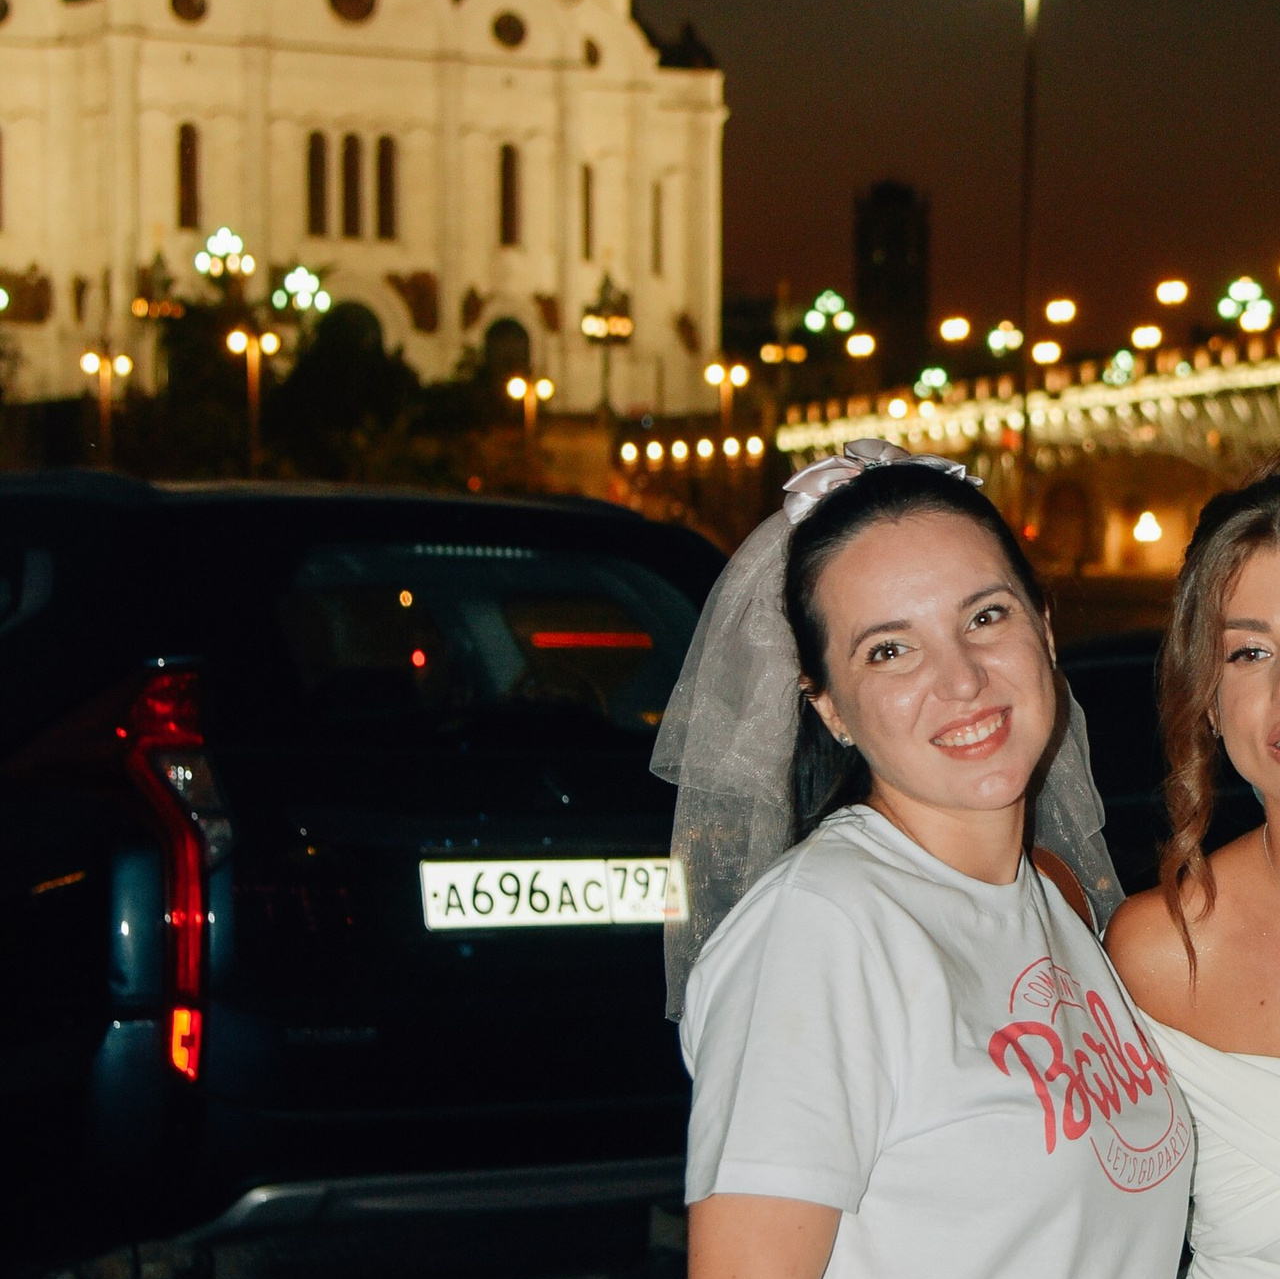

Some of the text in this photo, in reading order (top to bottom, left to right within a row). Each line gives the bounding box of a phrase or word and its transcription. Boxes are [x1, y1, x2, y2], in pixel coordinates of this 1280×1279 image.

[445, 867, 669, 916] A696AC 797
[1106, 1115, 1189, 1185] LET'S GO PARTY
